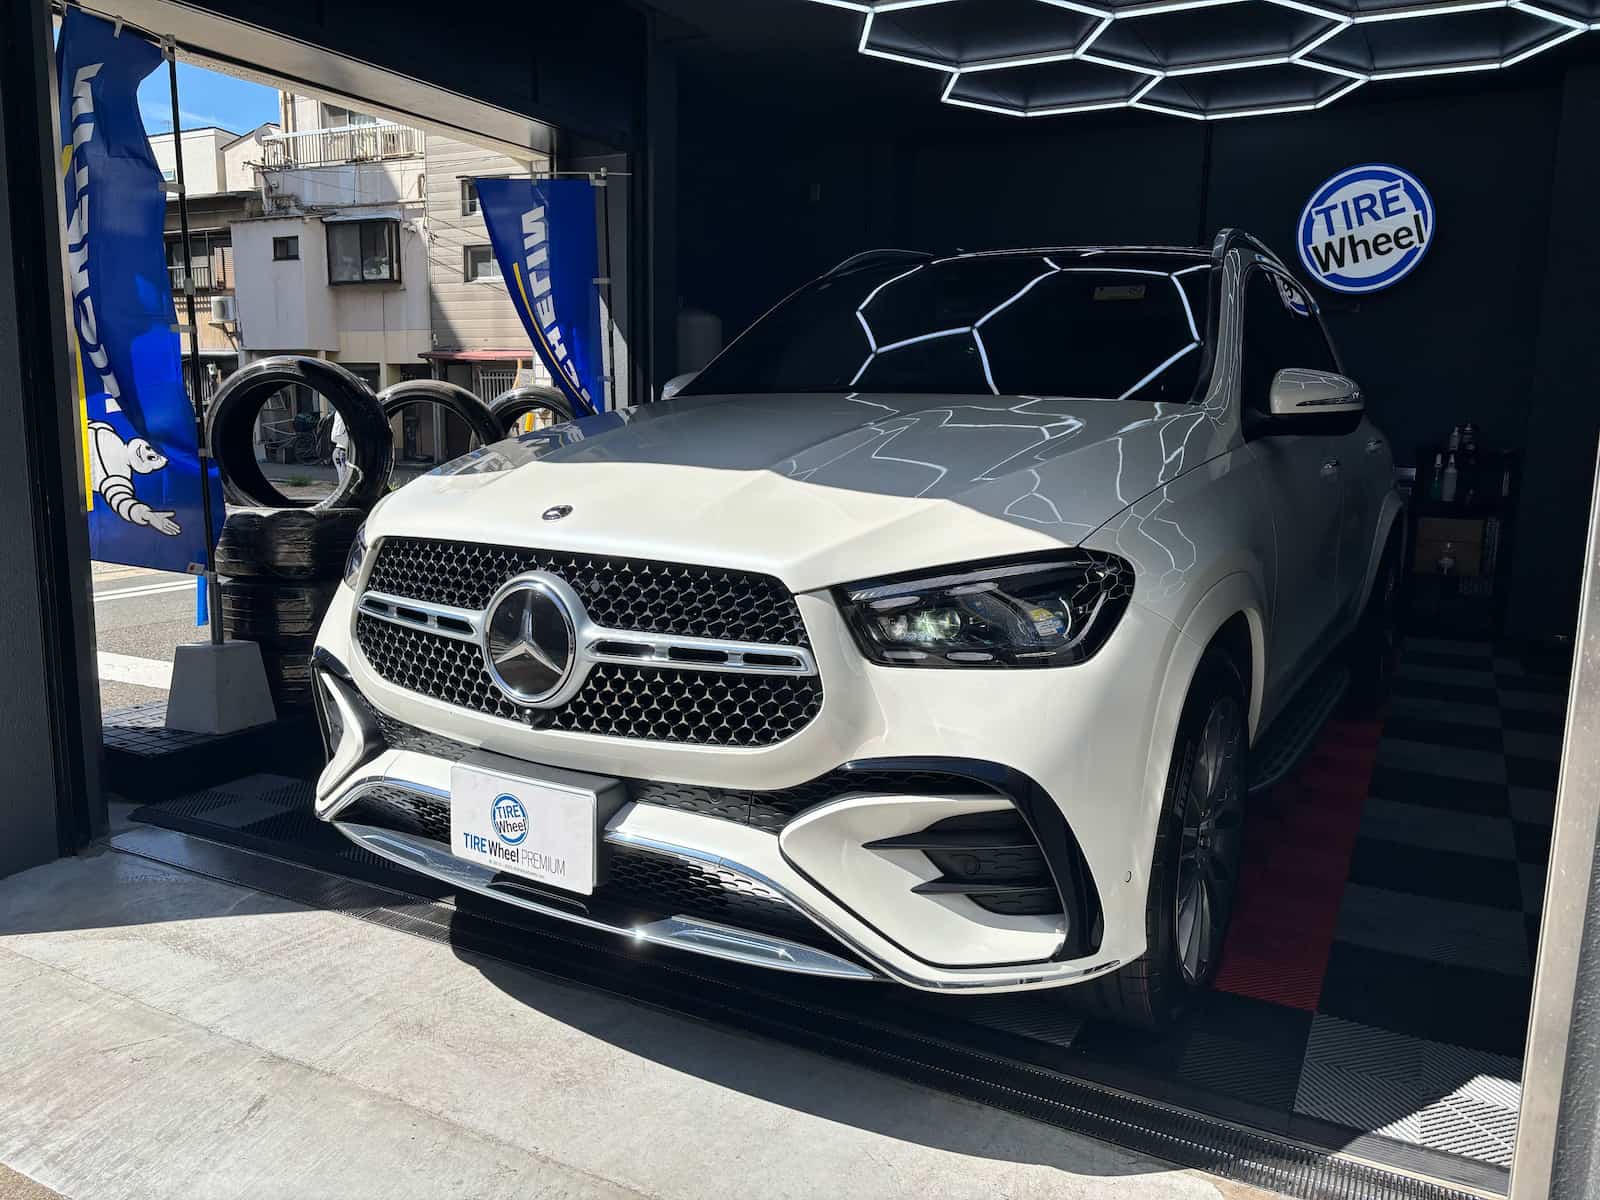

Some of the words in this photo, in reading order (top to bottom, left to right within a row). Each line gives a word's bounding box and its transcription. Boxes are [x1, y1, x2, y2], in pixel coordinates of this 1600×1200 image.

[1314, 182, 1406, 236] TIRE
[1311, 213, 1425, 273] Wheel
[496, 804, 521, 819] TIRE
[495, 818, 527, 834] Wheel
[521, 849, 566, 877] PREMIUM
